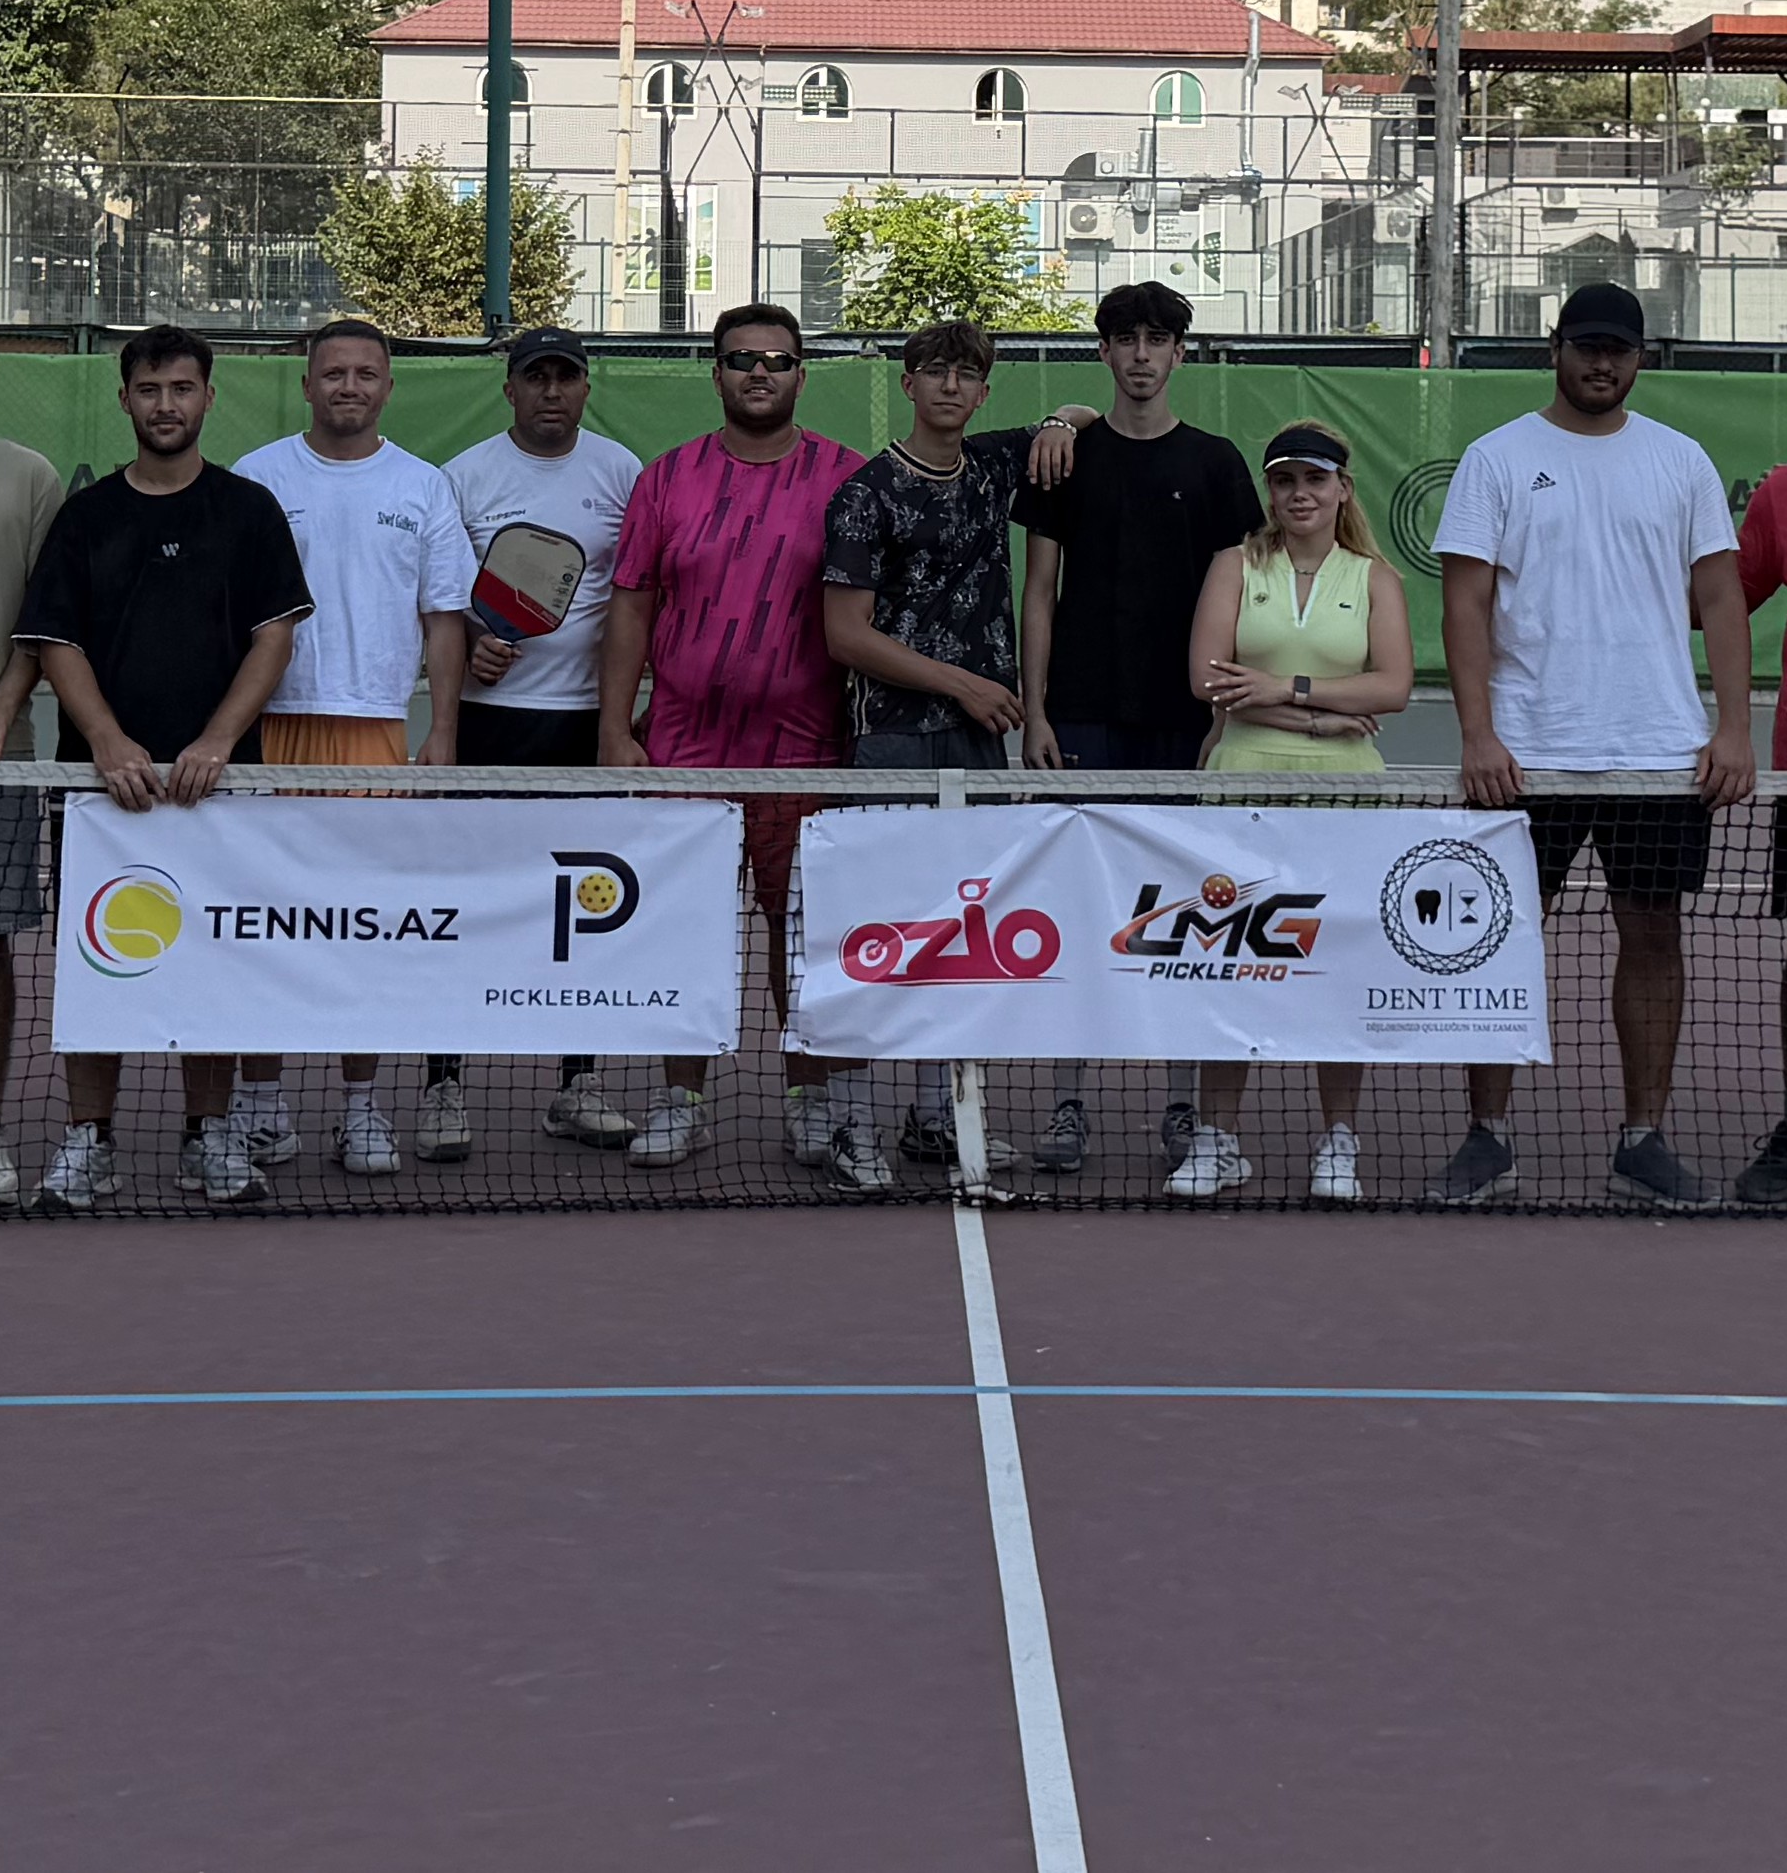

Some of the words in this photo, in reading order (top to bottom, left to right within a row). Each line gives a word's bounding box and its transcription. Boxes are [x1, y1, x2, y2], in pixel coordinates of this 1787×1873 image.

[204, 905, 460, 942] TENNIS.AZ
[1112, 883, 1328, 957] LMG
[1149, 961, 1289, 982] PICKLEPRO
[485, 988, 680, 1008] PICKLEBALL.AZ
[1366, 987, 1447, 1010] DENT
[1453, 987, 1529, 1010] TIME
